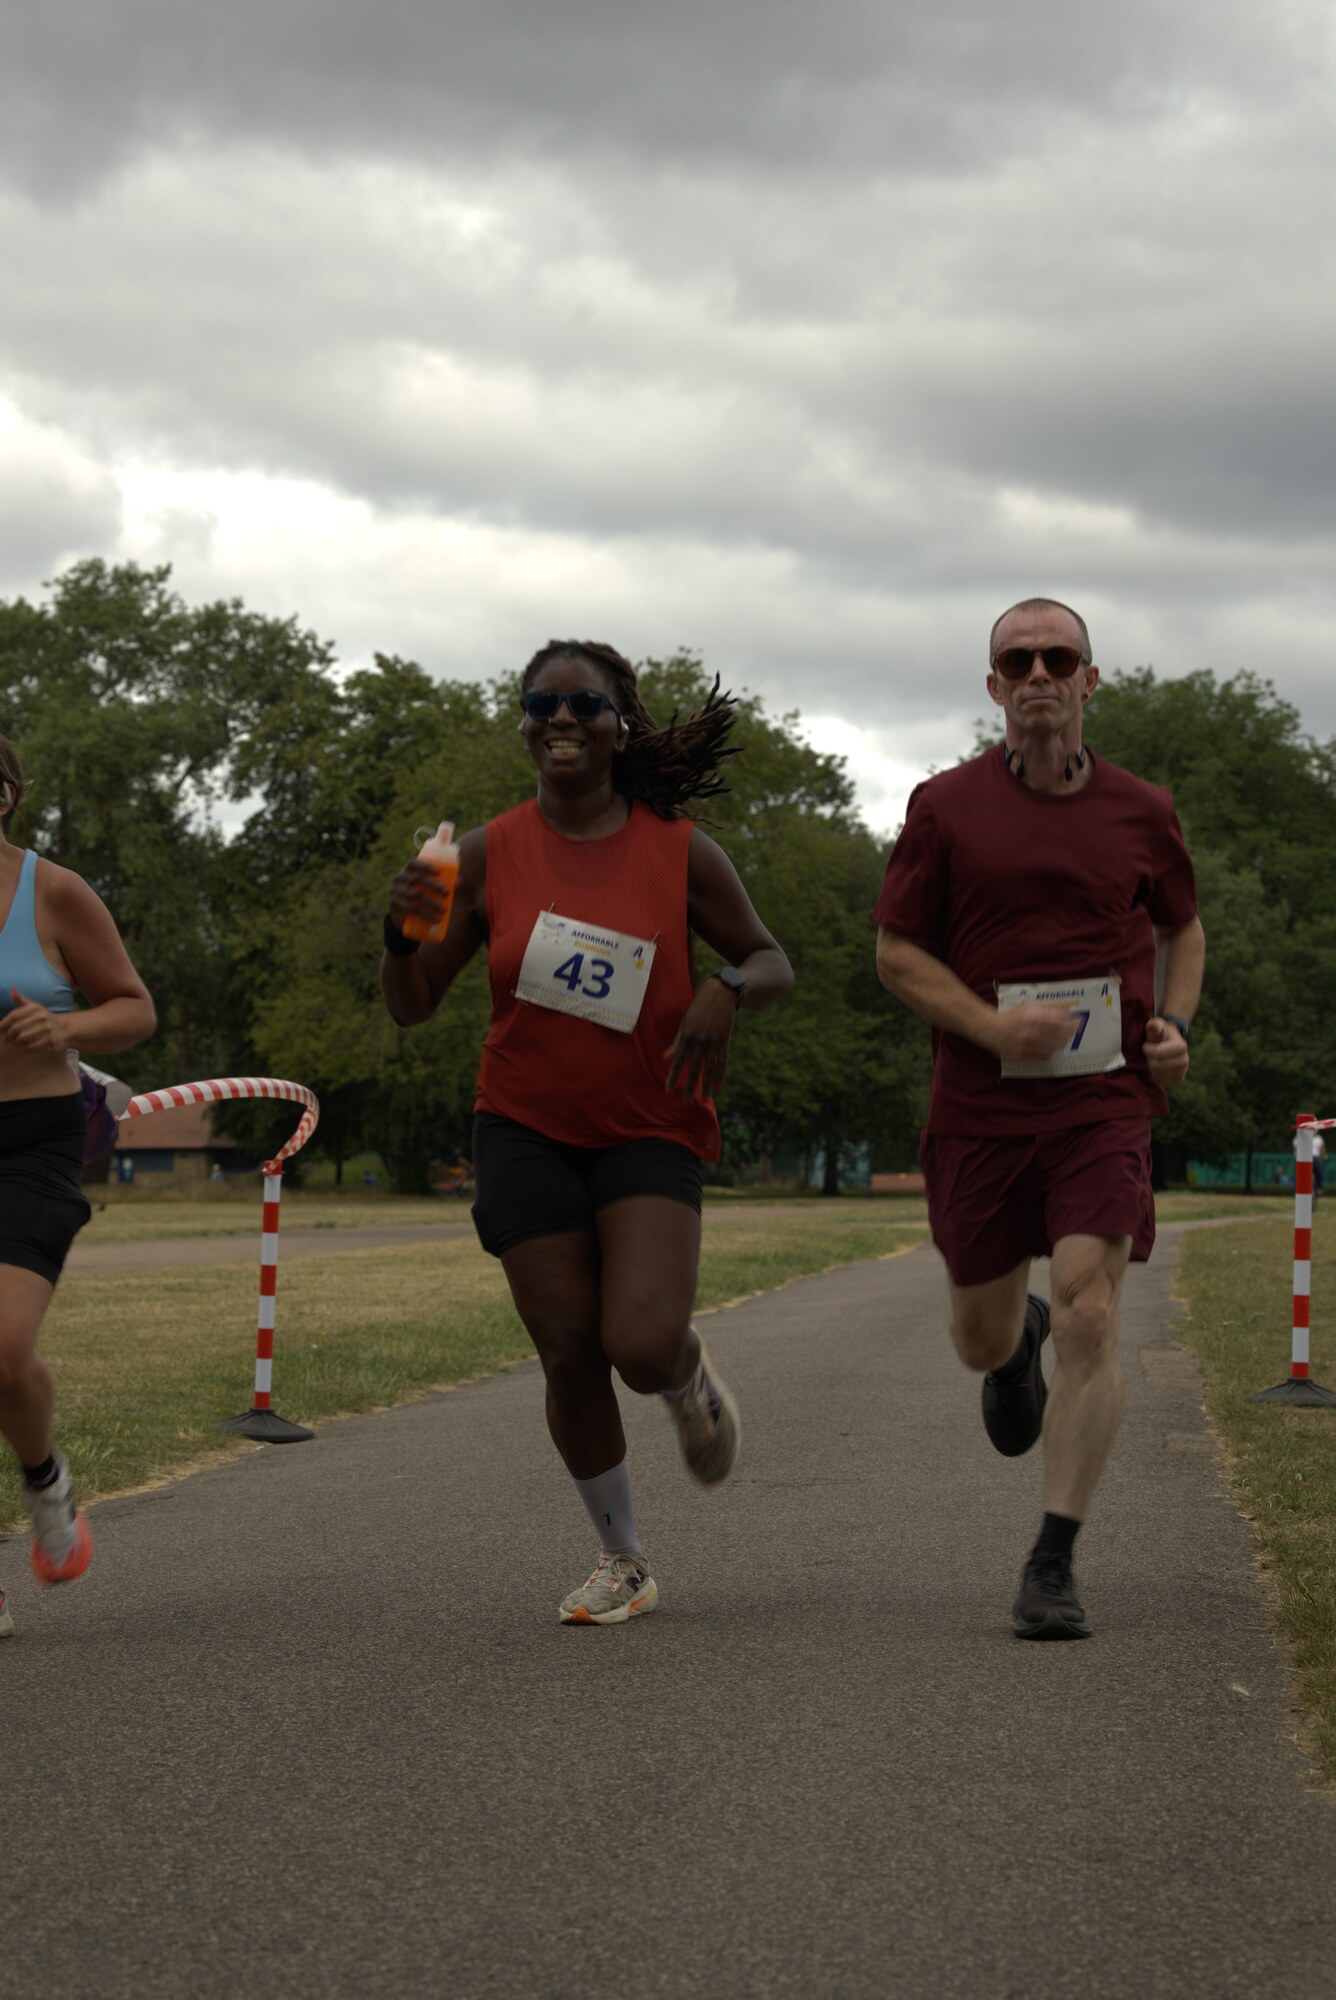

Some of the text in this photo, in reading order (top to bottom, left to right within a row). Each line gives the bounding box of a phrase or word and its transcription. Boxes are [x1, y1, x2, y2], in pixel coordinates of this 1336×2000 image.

[571, 929, 620, 949] AFFORDABLE
[553, 952, 615, 999] 43
[1068, 1009, 1090, 1051] 7
